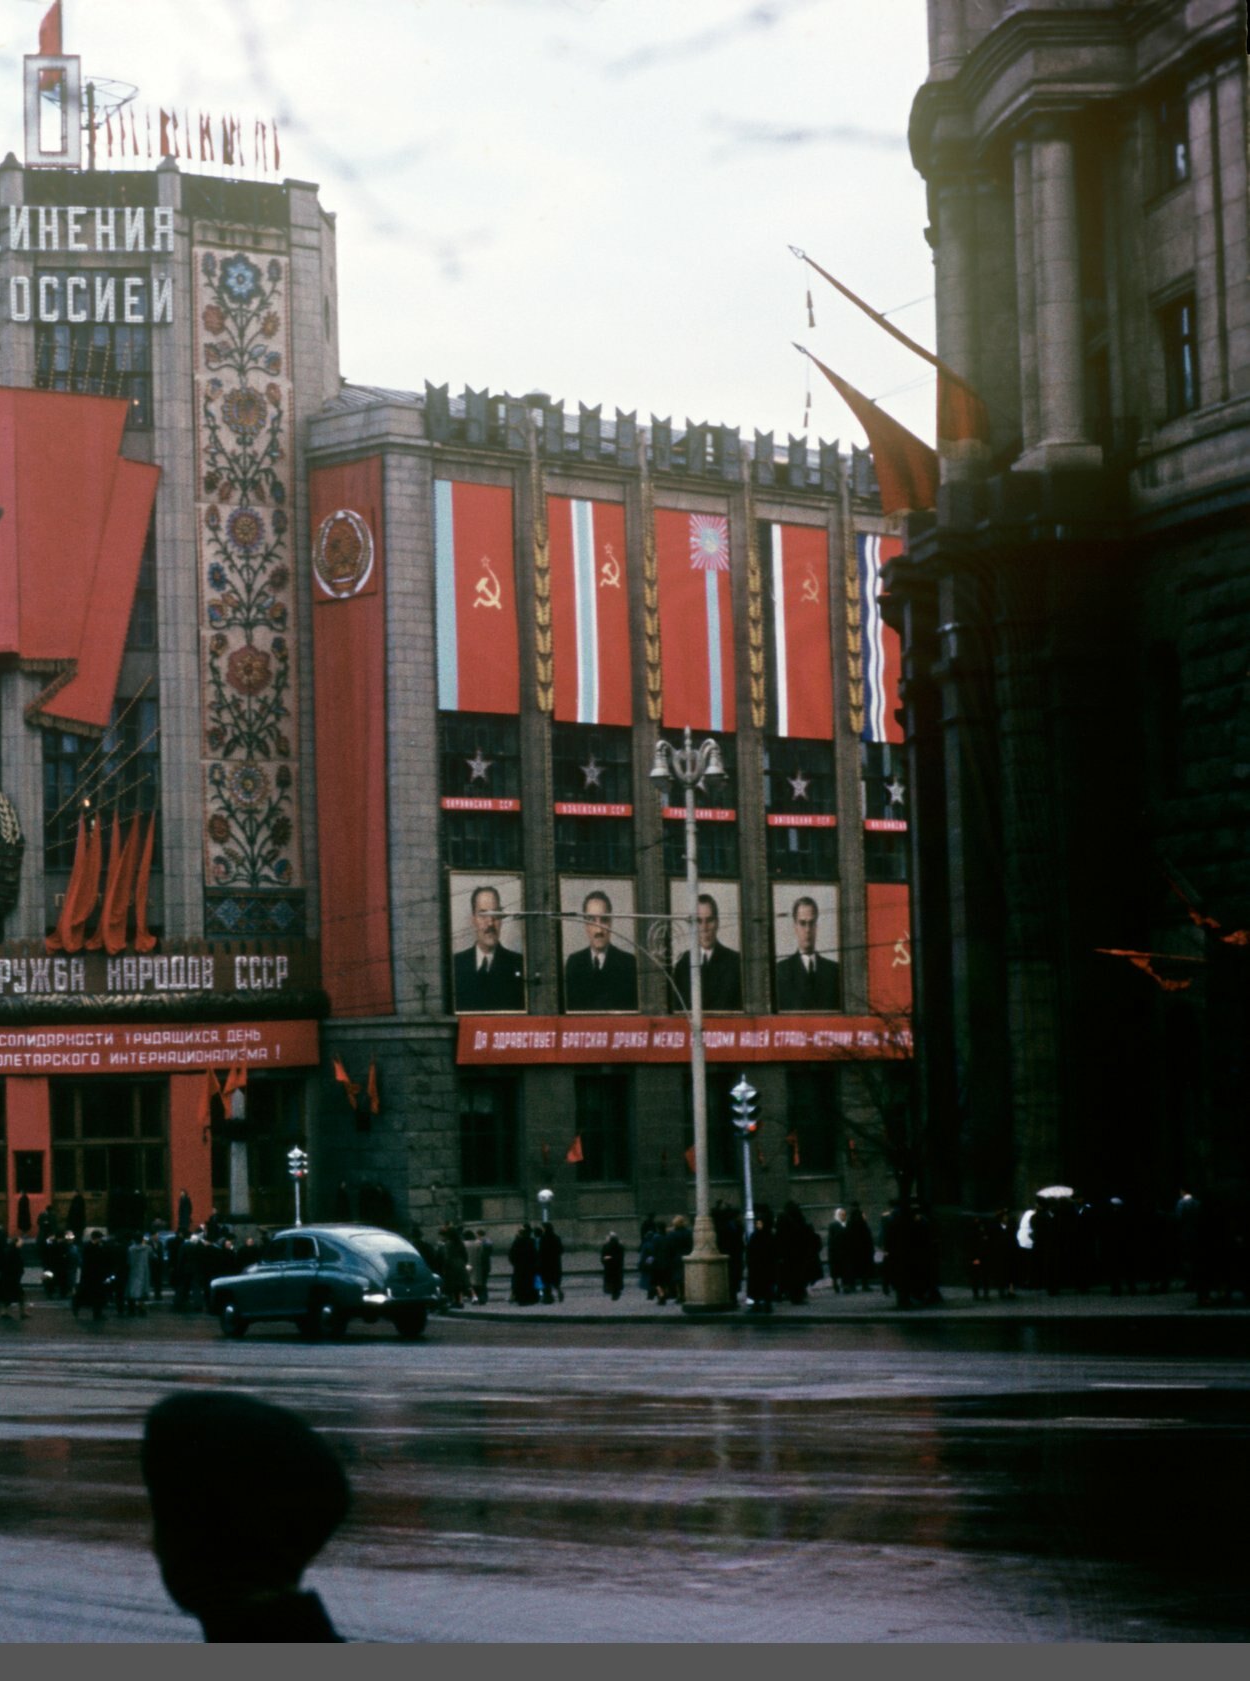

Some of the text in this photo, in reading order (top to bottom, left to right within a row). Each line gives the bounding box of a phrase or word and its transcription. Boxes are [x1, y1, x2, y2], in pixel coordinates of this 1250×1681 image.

[106, 955, 214, 993] НАРОДОВ
[235, 955, 288, 991] СССР
[226, 1029, 261, 1043] ДЕНЬ
[474, 1030, 488, 1050] ДА
[492, 1031, 557, 1050] ЗДРАВСТВУЕТ
[562, 1031, 609, 1049] БРАТСКАЯ
[612, 1031, 649, 1050] ДРУЖБА
[653, 1031, 686, 1049] МЕЖДУ
[109, 1047, 268, 1066] ИНТЕРНАЦИОНАЛИЗМА
